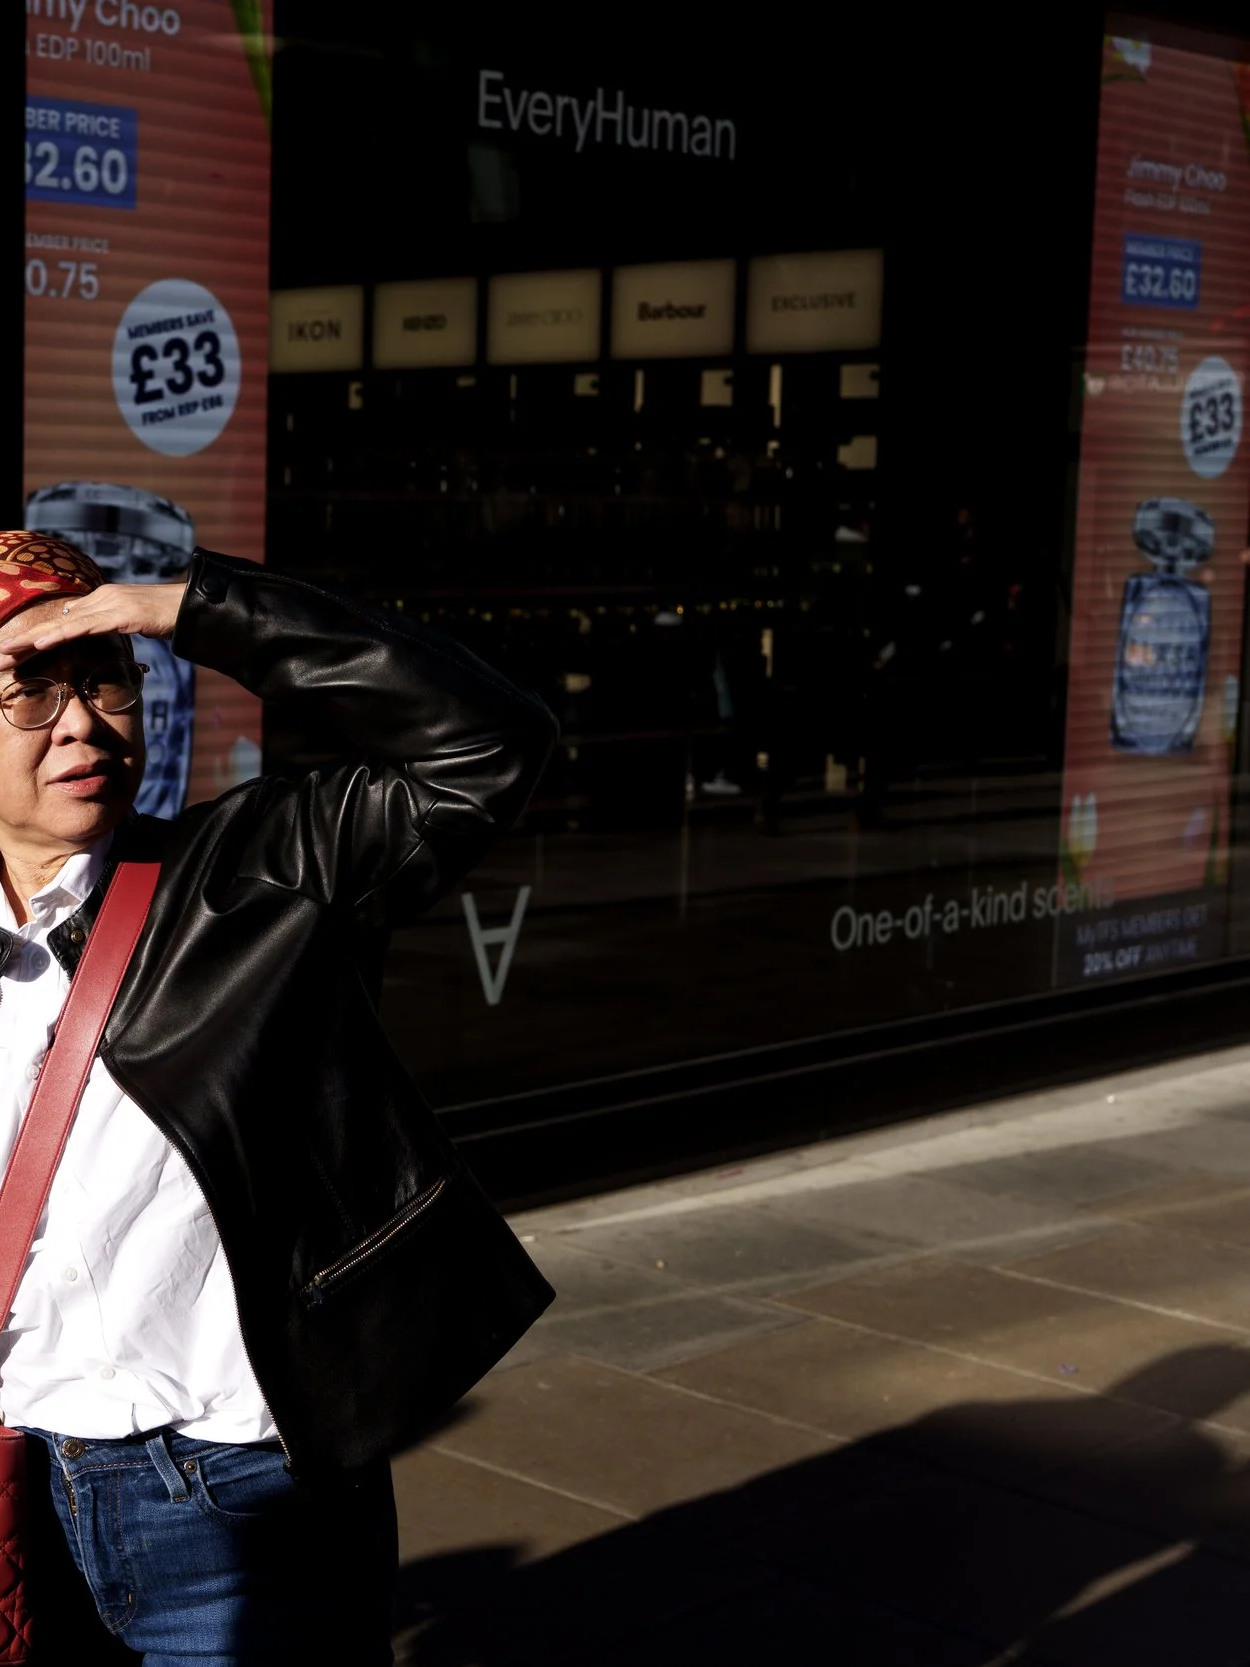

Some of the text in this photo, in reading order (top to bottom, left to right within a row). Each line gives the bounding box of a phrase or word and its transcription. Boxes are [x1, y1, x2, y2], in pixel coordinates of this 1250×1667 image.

[95, 0, 180, 35] Choo
[36, 33, 79, 61] EDP
[85, 38, 151, 71] 100ml
[65, 111, 121, 140] PRICE
[478, 69, 736, 160] EveryHuman
[73, 236, 110, 254] PRICE
[1125, 262, 1197, 301] £32.60
[637, 299, 706, 322] Barbour
[771, 291, 856, 313] EXCLUSIVE
[128, 309, 214, 339] MEMBERS SAVE
[287, 318, 342, 342] IKON
[130, 330, 225, 405] £33
[142, 407, 175, 426] FROM
[1190, 392, 1235, 443] £33
[831, 878, 1115, 951] One-of-a-kind scents
[1083, 951, 1113, 976] 20%
[1115, 945, 1142, 970] OFF
